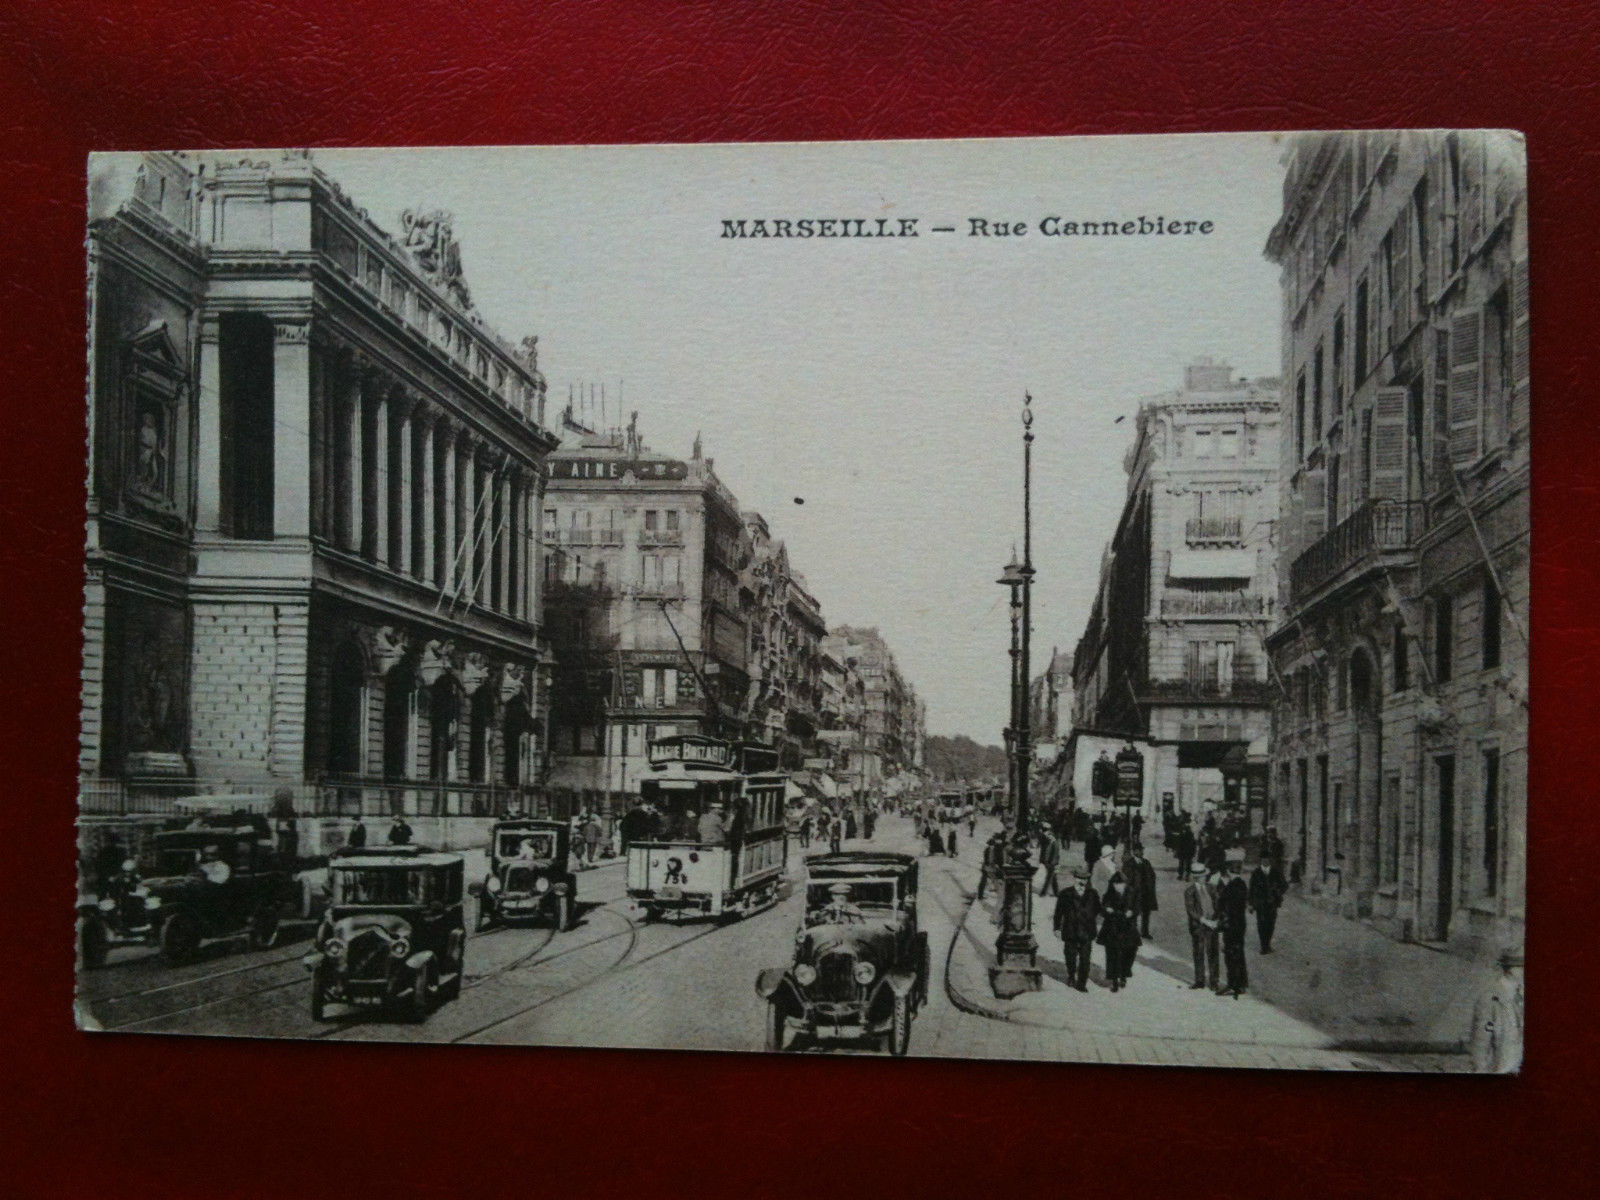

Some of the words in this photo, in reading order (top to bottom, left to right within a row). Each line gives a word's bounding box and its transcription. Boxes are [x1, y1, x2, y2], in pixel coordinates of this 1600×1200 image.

[720, 219, 919, 239] MARSEILLE
[967, 217, 1028, 237] Rue
[1039, 215, 1214, 236] Cannebiere
